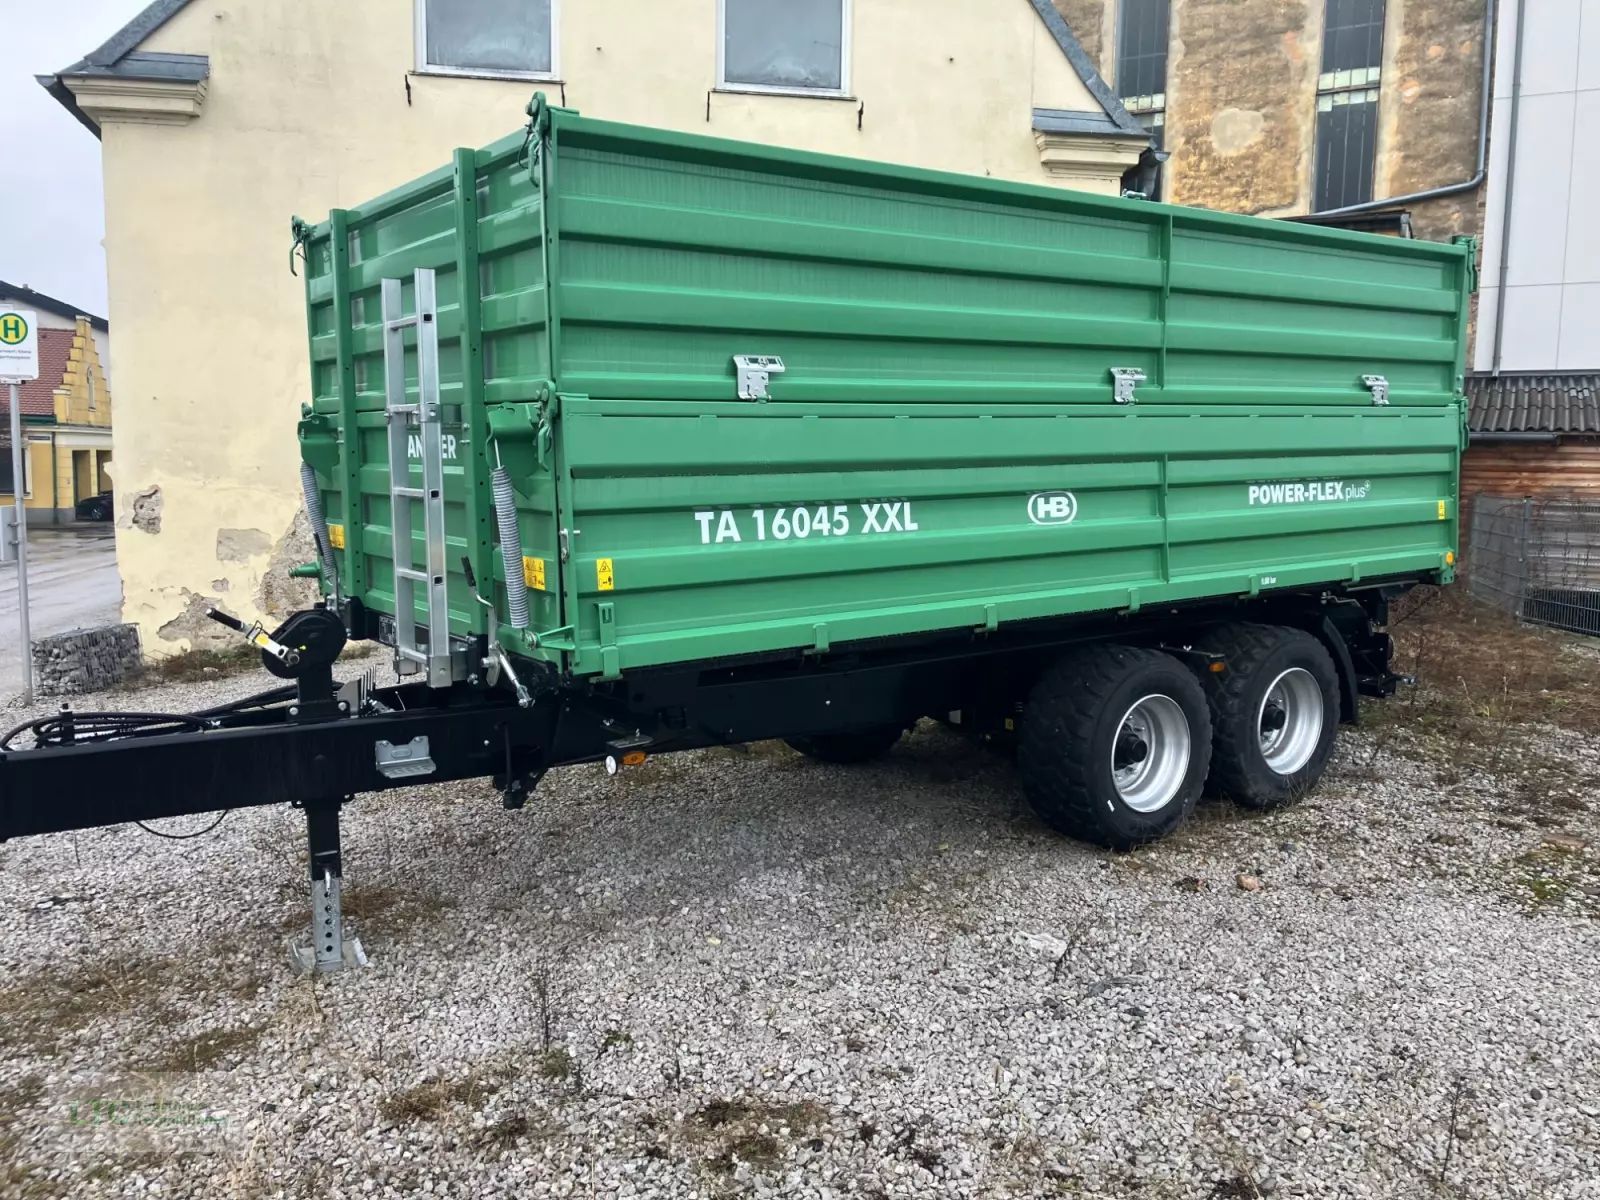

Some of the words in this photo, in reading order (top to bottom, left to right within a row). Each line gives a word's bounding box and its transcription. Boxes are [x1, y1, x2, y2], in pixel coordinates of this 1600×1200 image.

[3, 319, 20, 339] H
[407, 434, 457, 459] ANER
[1248, 481, 1344, 505] POWER-FLEX
[1036, 496, 1070, 519] HB
[694, 510, 742, 544] TA
[752, 505, 849, 541] 16045
[861, 502, 919, 534] XXL
